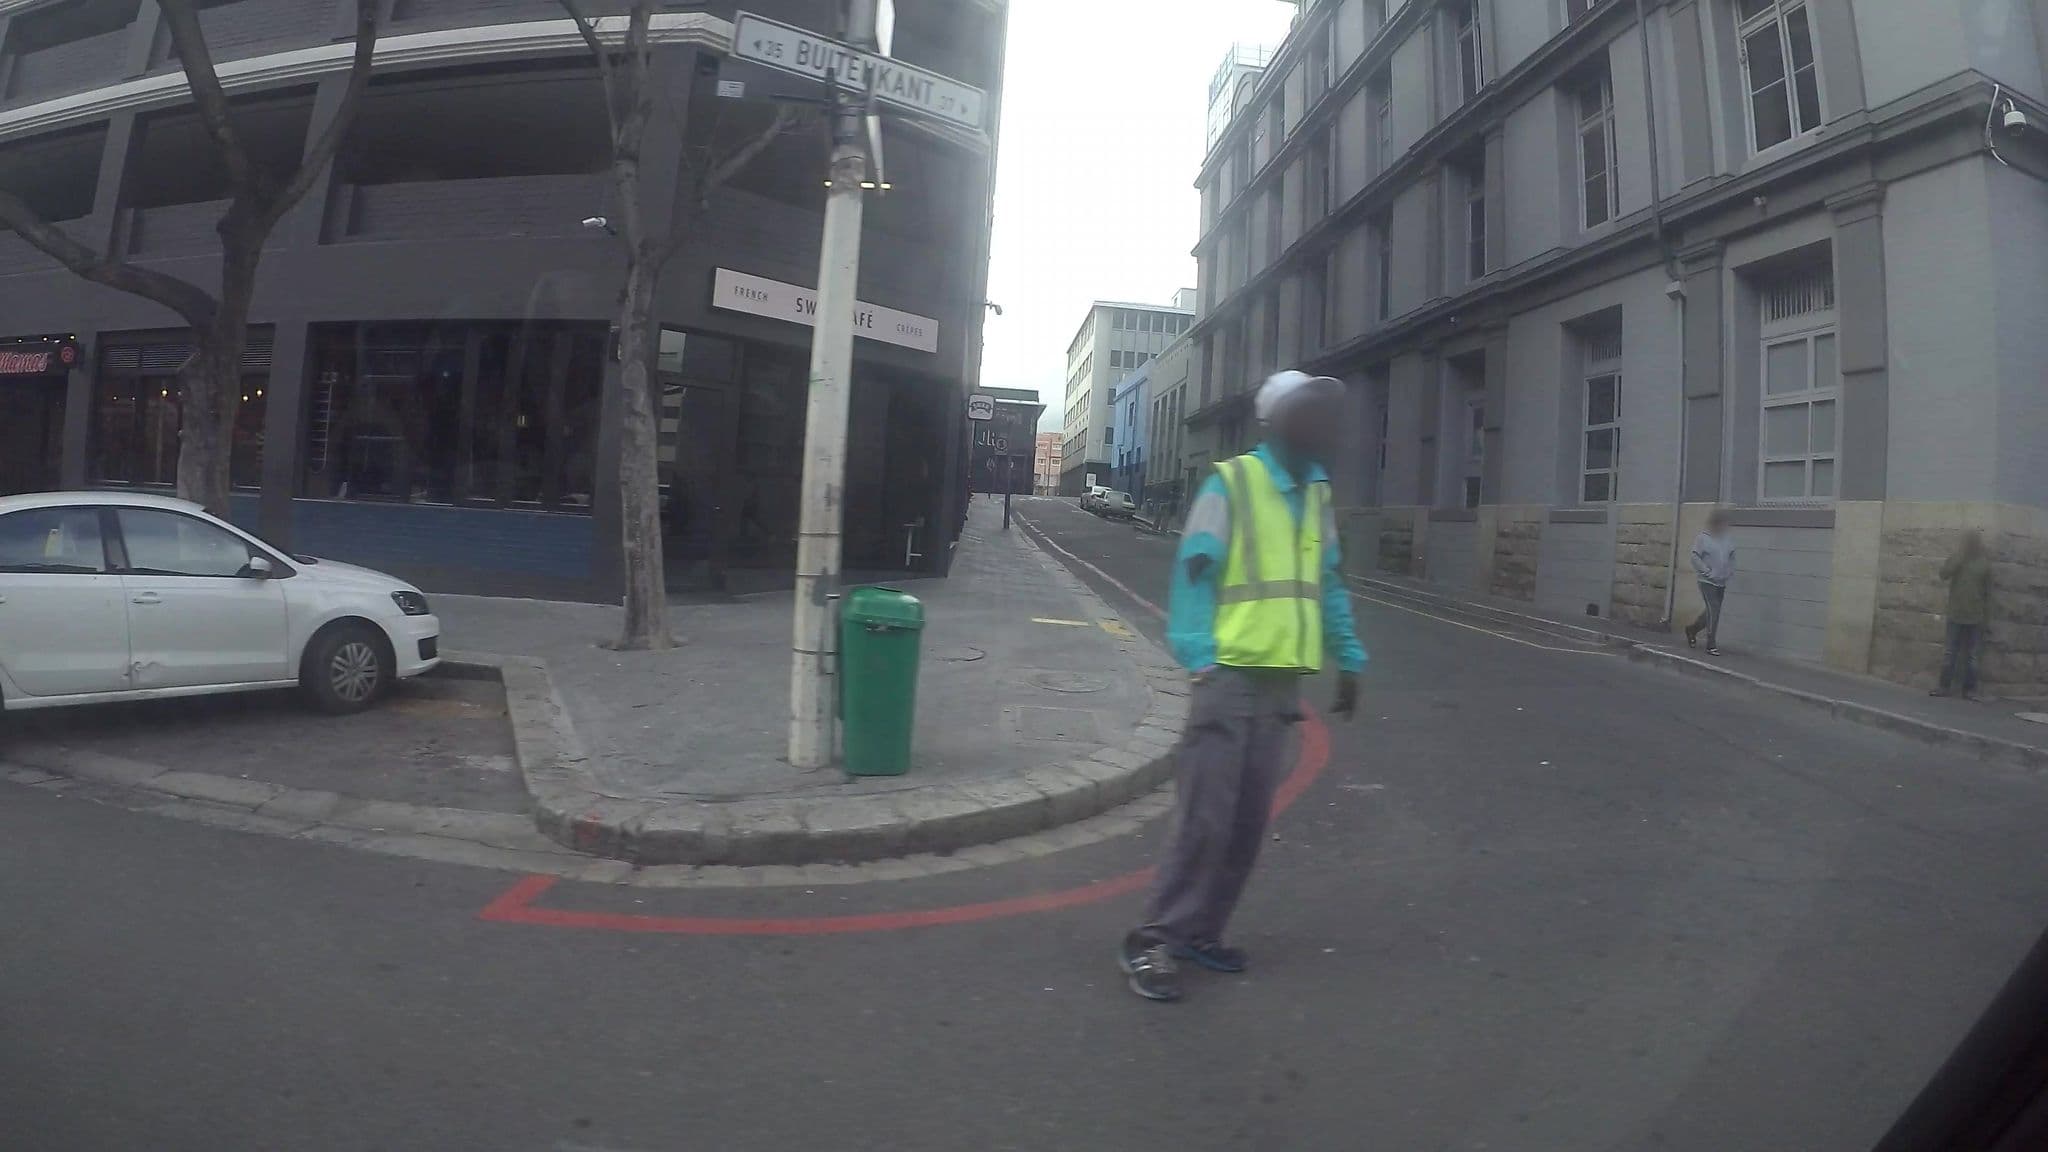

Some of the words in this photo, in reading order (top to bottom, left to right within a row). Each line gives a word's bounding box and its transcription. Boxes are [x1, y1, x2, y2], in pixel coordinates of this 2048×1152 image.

[764, 42, 783, 60] 35
[796, 40, 935, 105] BUITENKANT
[734, 286, 768, 301] FRENCH
[852, 310, 873, 329] AFÉ
